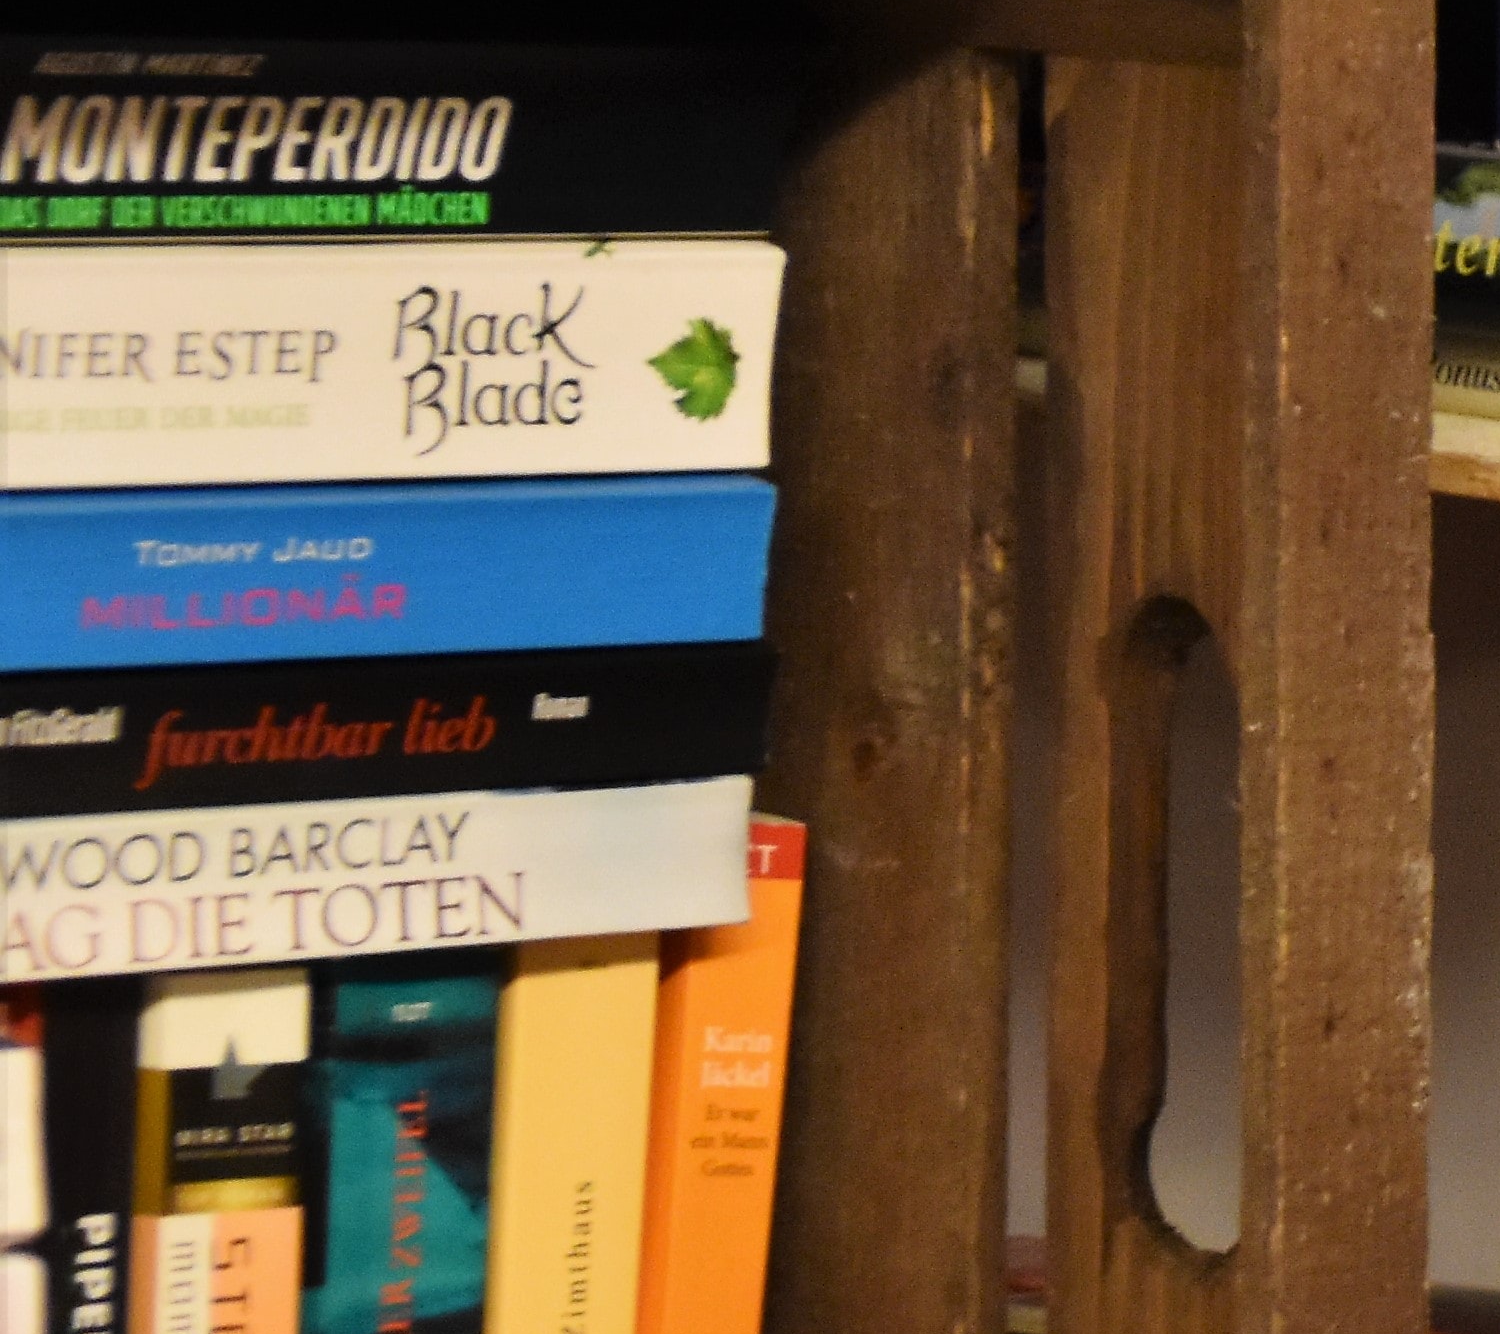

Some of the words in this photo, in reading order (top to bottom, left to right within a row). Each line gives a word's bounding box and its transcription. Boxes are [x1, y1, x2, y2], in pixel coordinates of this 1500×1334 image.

[1, 93, 513, 183] MONTEPERDIDO
[174, 328, 339, 382] ESTEP
[80, 575, 407, 630] MILLIONÄR
[136, 701, 391, 791] furchtbar
[404, 696, 497, 754] lieb
[229, 810, 470, 878] BARCLAY
[129, 888, 254, 965] DIE
[272, 868, 528, 952] TOTEN
